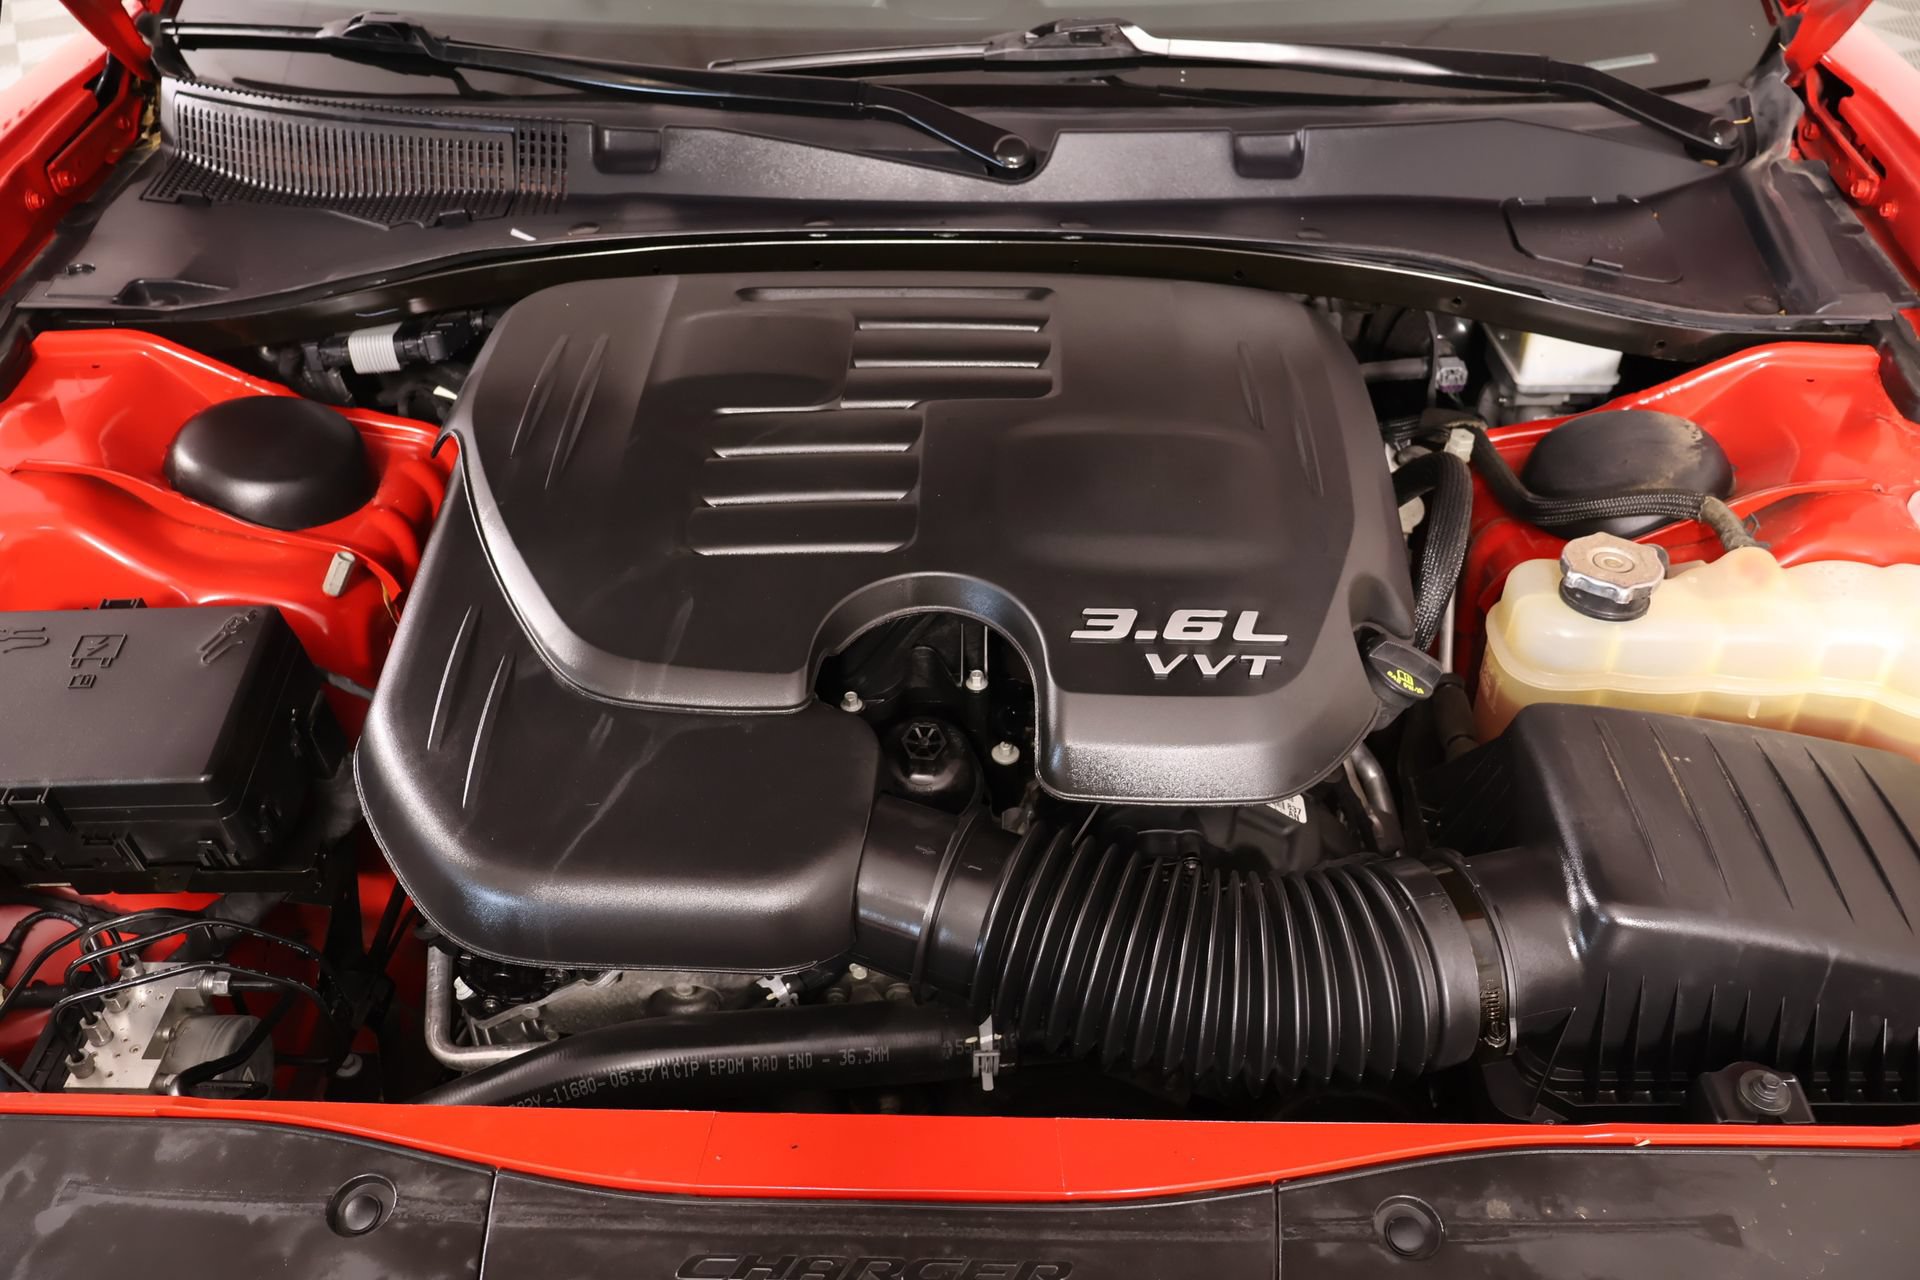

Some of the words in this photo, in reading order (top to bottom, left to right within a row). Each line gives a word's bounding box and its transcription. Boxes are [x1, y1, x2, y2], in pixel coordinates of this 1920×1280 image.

[1070, 607, 1288, 642] 3.6L
[1145, 653, 1282, 677] VVT
[709, 1057, 745, 1076] EPDM
[788, 1052, 813, 1070] END
[839, 1047, 890, 1067] 36.3MM
[675, 1254, 1074, 1280] CHARGER
